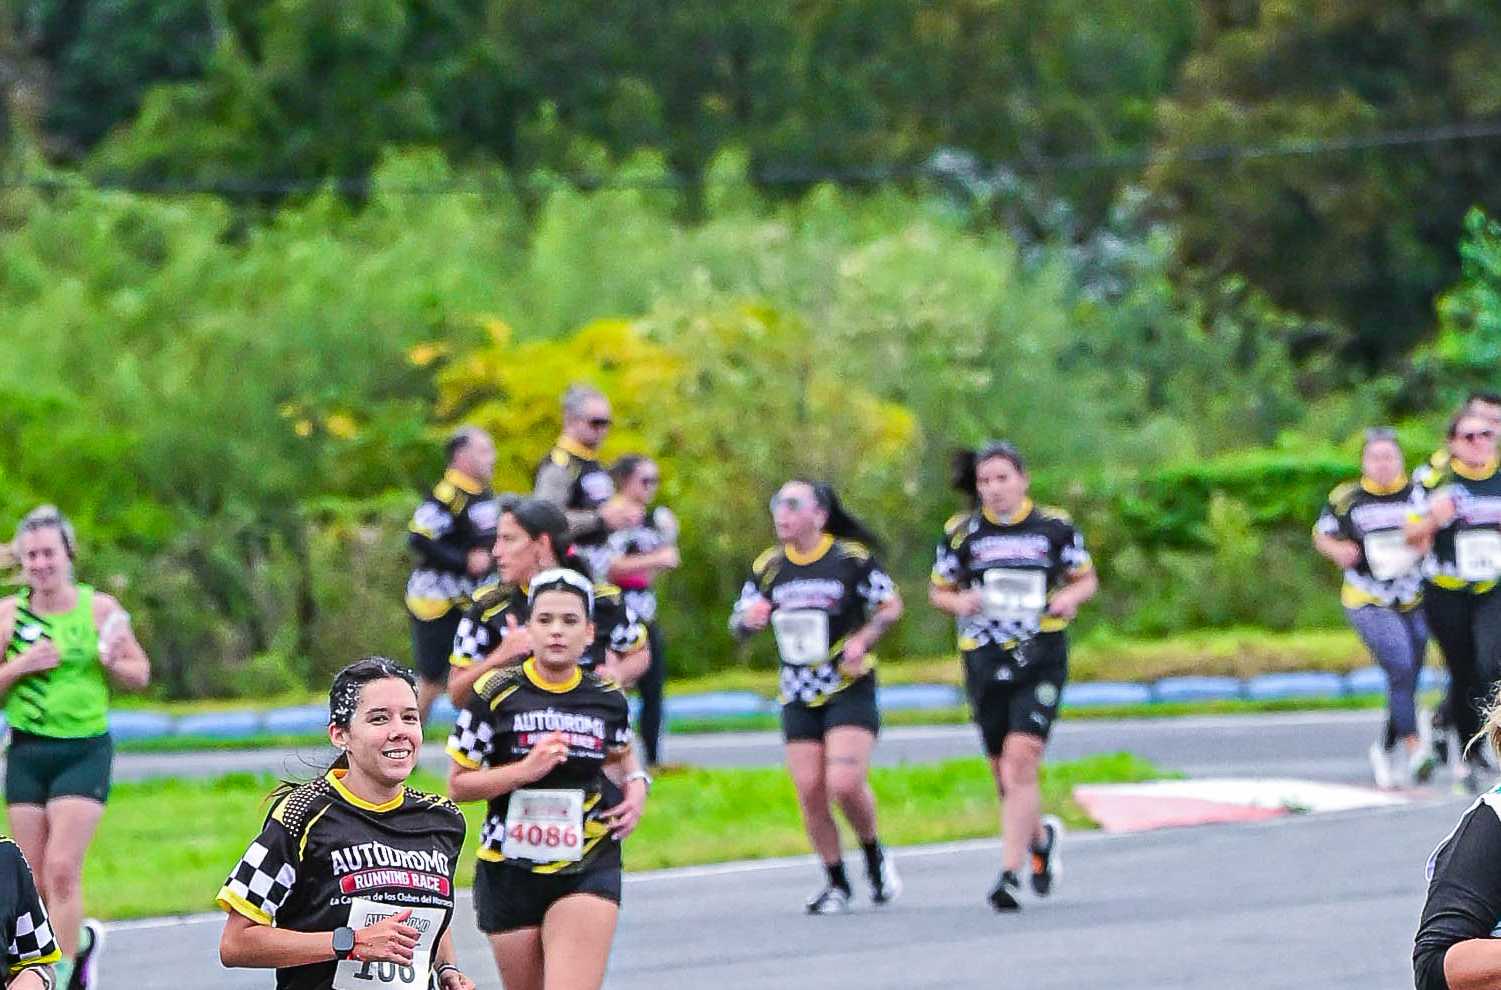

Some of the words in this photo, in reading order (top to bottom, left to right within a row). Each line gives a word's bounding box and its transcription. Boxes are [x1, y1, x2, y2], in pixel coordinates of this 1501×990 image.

[509, 822, 578, 848] 4086
[354, 870, 410, 889] RUNNING
[411, 872, 441, 892] RACE
[330, 897, 340, 906] La
[372, 892, 384, 901] de
[420, 895, 432, 904] del
